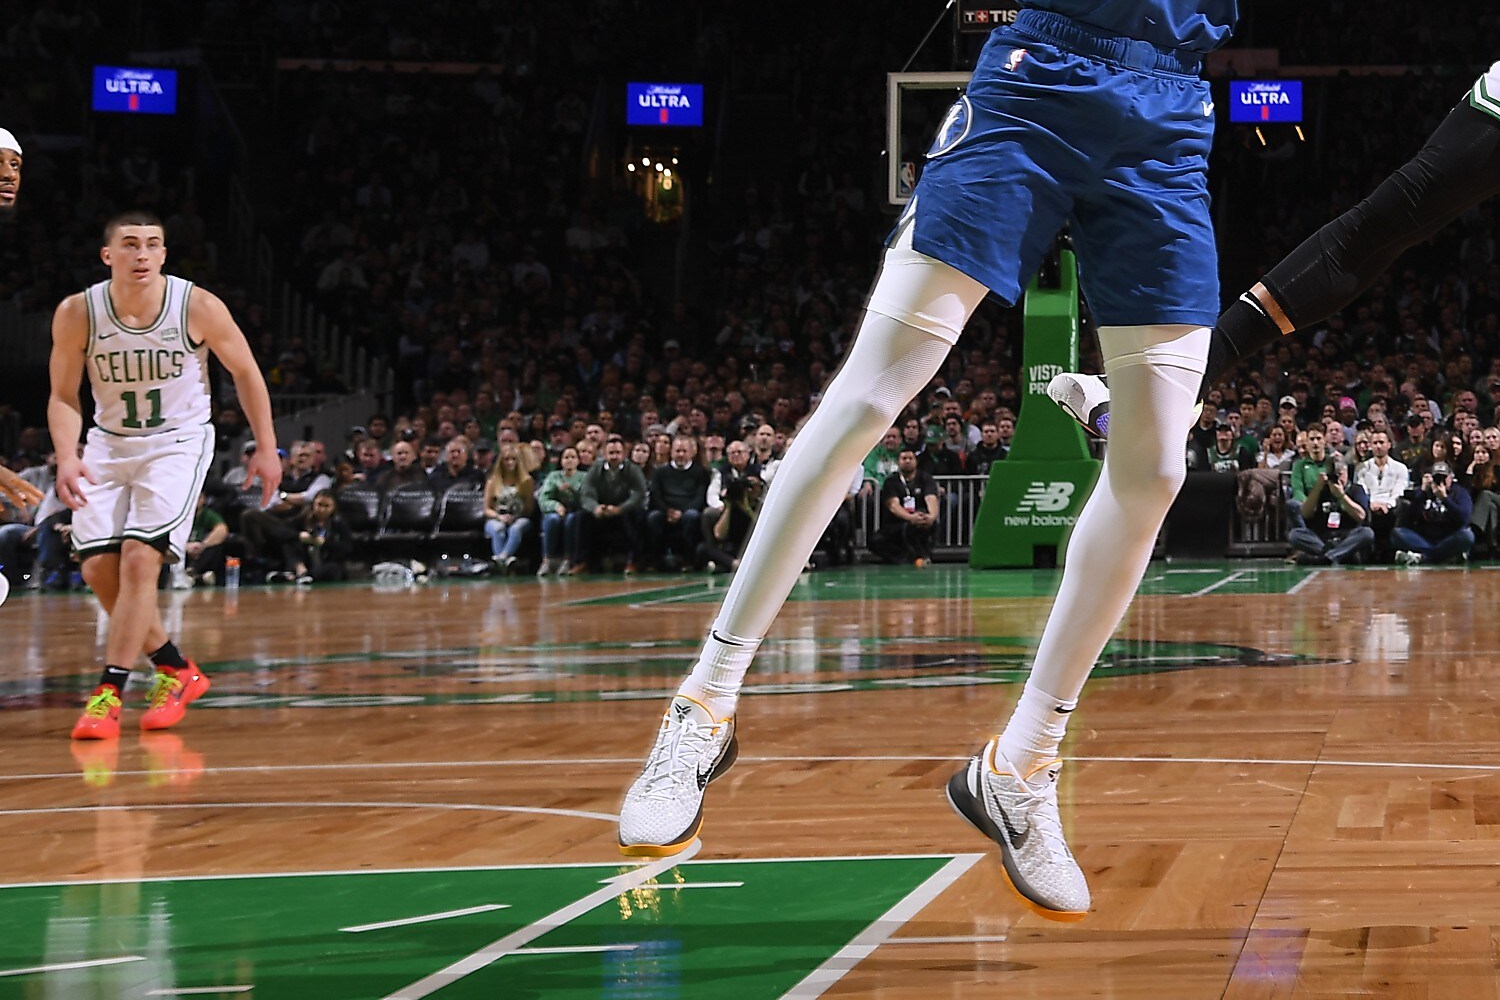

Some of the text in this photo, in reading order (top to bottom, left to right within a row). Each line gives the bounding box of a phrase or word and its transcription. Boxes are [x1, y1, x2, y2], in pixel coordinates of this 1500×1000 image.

[989, 10, 1018, 23] TIS
[105, 78, 163, 95] ULTRA
[638, 94, 691, 108] ULTRA
[1240, 91, 1291, 105] ULTRA
[94, 349, 185, 382] CELTICS
[121, 388, 166, 428] 11
[1004, 514, 1076, 527] new balanc
